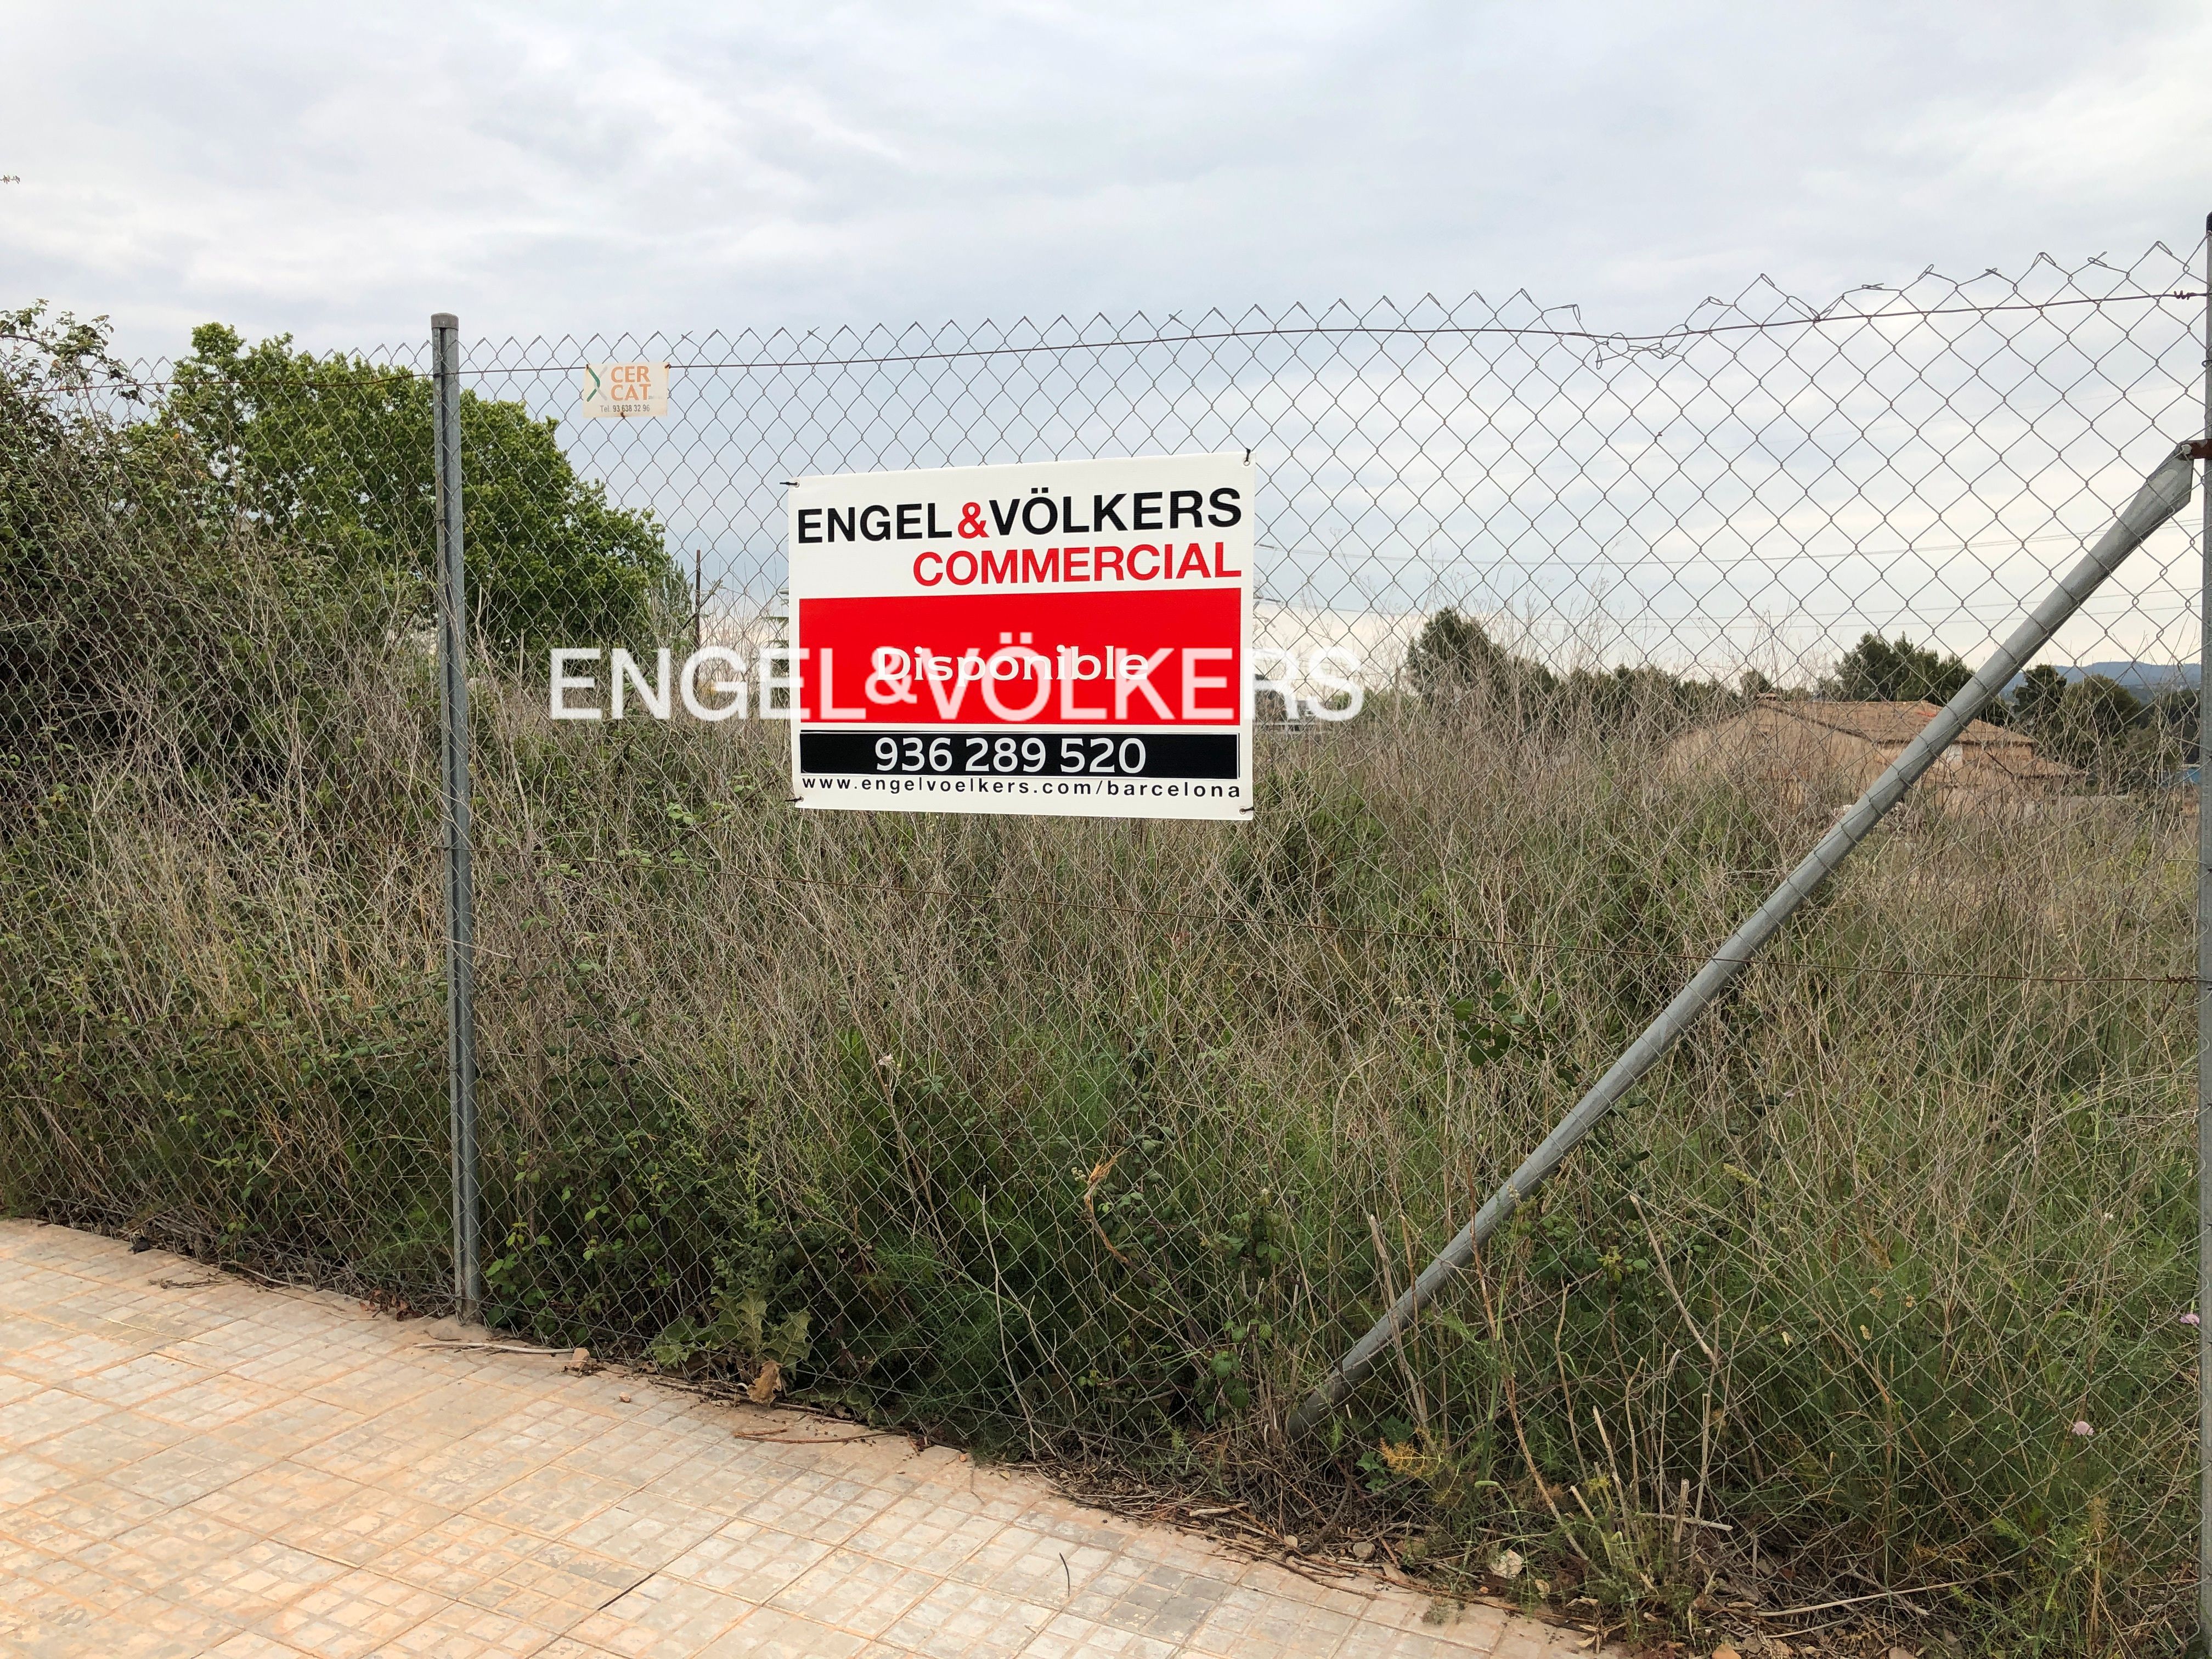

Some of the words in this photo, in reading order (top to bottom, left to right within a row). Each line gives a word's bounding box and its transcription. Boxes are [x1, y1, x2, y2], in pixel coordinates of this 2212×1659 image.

[611, 366, 651, 383] CER
[611, 383, 651, 401] CAT
[612, 404, 620, 413] 93
[622, 404, 633, 413] 638
[634, 404, 641, 412] 32
[642, 404, 650, 412] 96
[798, 487, 1242, 544] ENGEL&VÖLKERS
[913, 542, 1242, 586] COMMERCIAL
[877, 645, 1149, 687] Disponible
[874, 737, 953, 772] 936
[964, 737, 1047, 774] 289
[1060, 738, 1147, 775] 520
[802, 777, 1241, 799] www.engelvoelkers.com/barcelona
